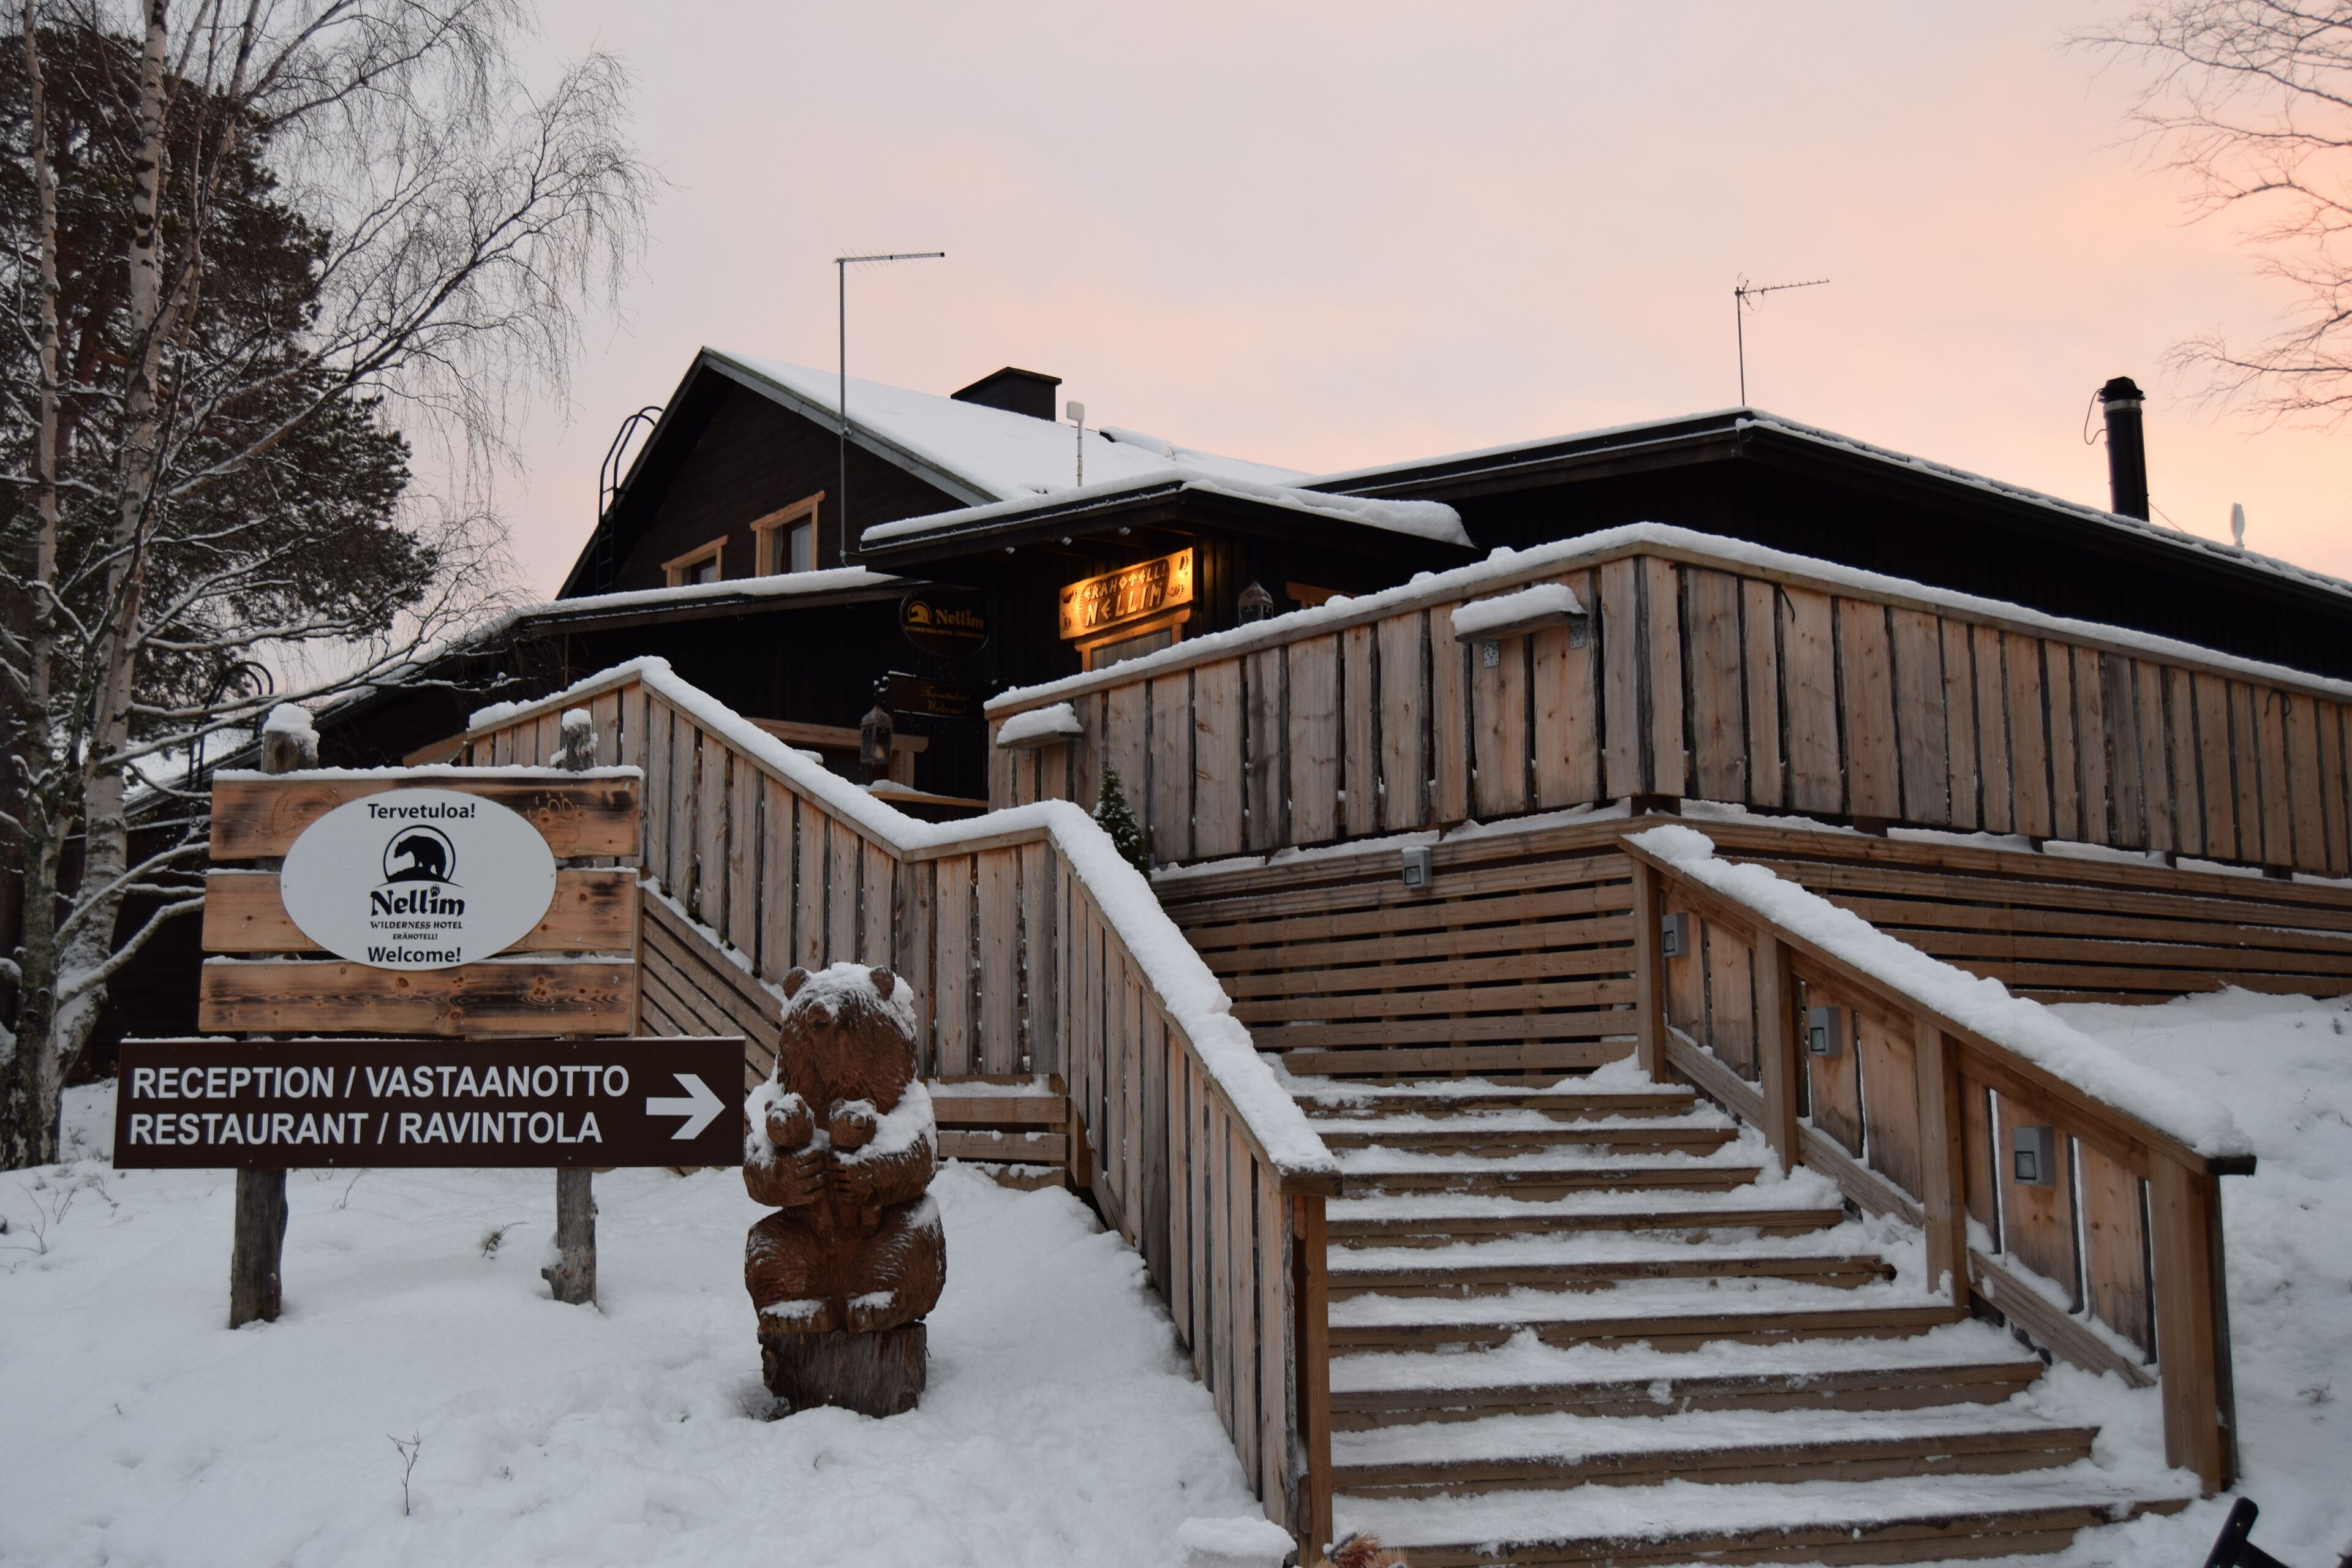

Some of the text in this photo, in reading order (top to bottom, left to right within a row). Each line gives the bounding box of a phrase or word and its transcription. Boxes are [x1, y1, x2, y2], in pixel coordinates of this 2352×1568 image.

[1085, 582, 1163, 627] NELLIM
[935, 608, 985, 630] Nellim
[905, 625, 937, 635] WILDERNESS
[927, 699, 967, 715] Welcome!
[368, 802, 475, 819] Tervetuloa!
[370, 884, 466, 916] Nellim
[370, 921, 462, 930] WILDERNESS HOTEL
[393, 932, 438, 941] ERÄHOTELLI
[368, 946, 461, 963] Welcome!
[133, 1066, 334, 1098] RECEPTION
[366, 1065, 630, 1098] VASTAANOTTO
[130, 1112, 369, 1145] RESTAURANT
[399, 1111, 603, 1144] RAVINTOLA
